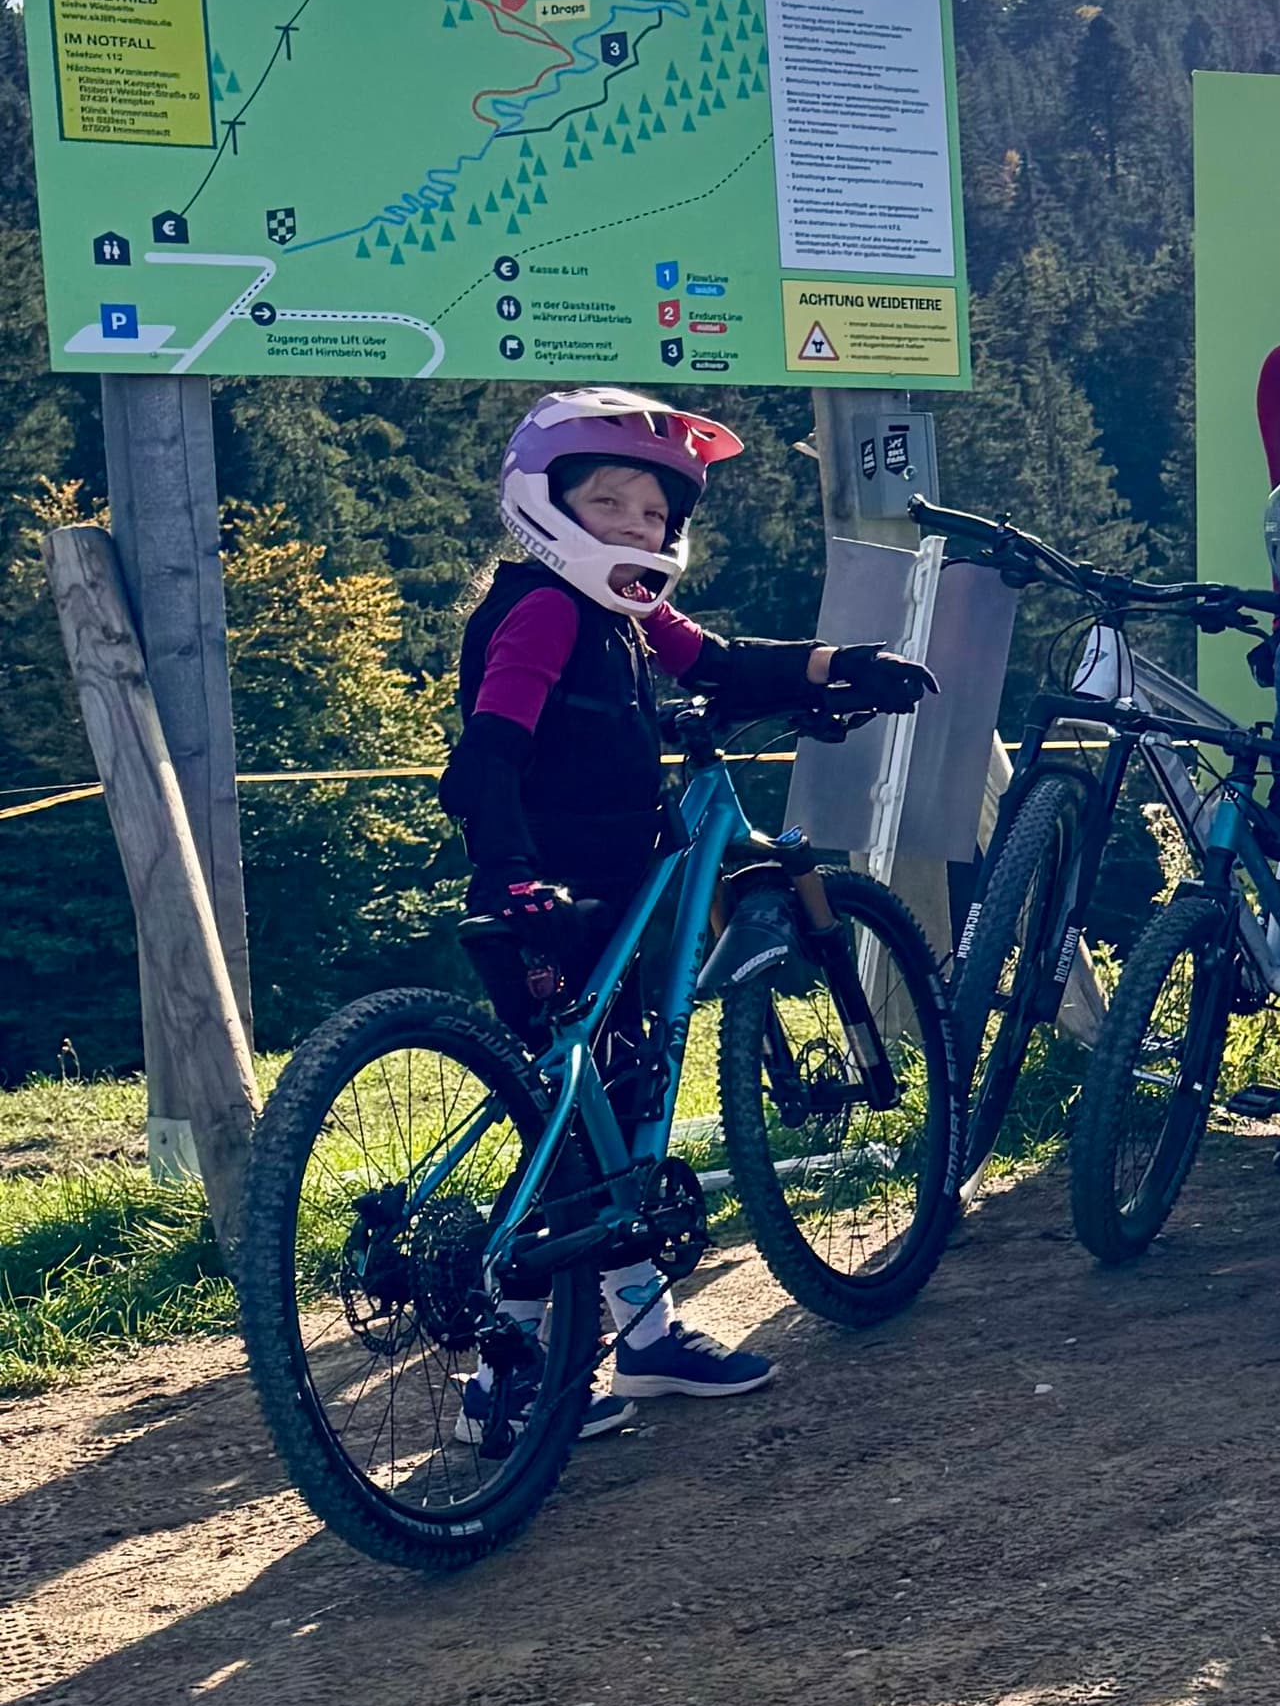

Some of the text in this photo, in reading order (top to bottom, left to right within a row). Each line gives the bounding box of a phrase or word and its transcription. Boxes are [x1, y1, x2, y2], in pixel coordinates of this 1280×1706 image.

[551, 3, 585, 16] Drops
[64, 32, 156, 50] IM NOTFALL
[610, 42, 621, 56] 3
[529, 265, 589, 276] Kasse & Lift
[663, 269, 670, 282] 1
[543, 301, 559, 309] der
[562, 301, 616, 311] Gaststätte
[799, 293, 942, 311] ACHTUNG WEIDETIERE
[532, 312, 632, 324] während Liftbetrieb
[664, 306, 674, 321] 2
[112, 312, 127, 330] P
[266, 333, 309, 346] Zugang
[311, 335, 338, 345] ohne
[341, 335, 360, 345] Lift
[596, 340, 612, 350] mit
[267, 346, 288, 356] den
[291, 346, 313, 356] Carl
[364, 348, 387, 360] Weg
[667, 344, 678, 358] 3
